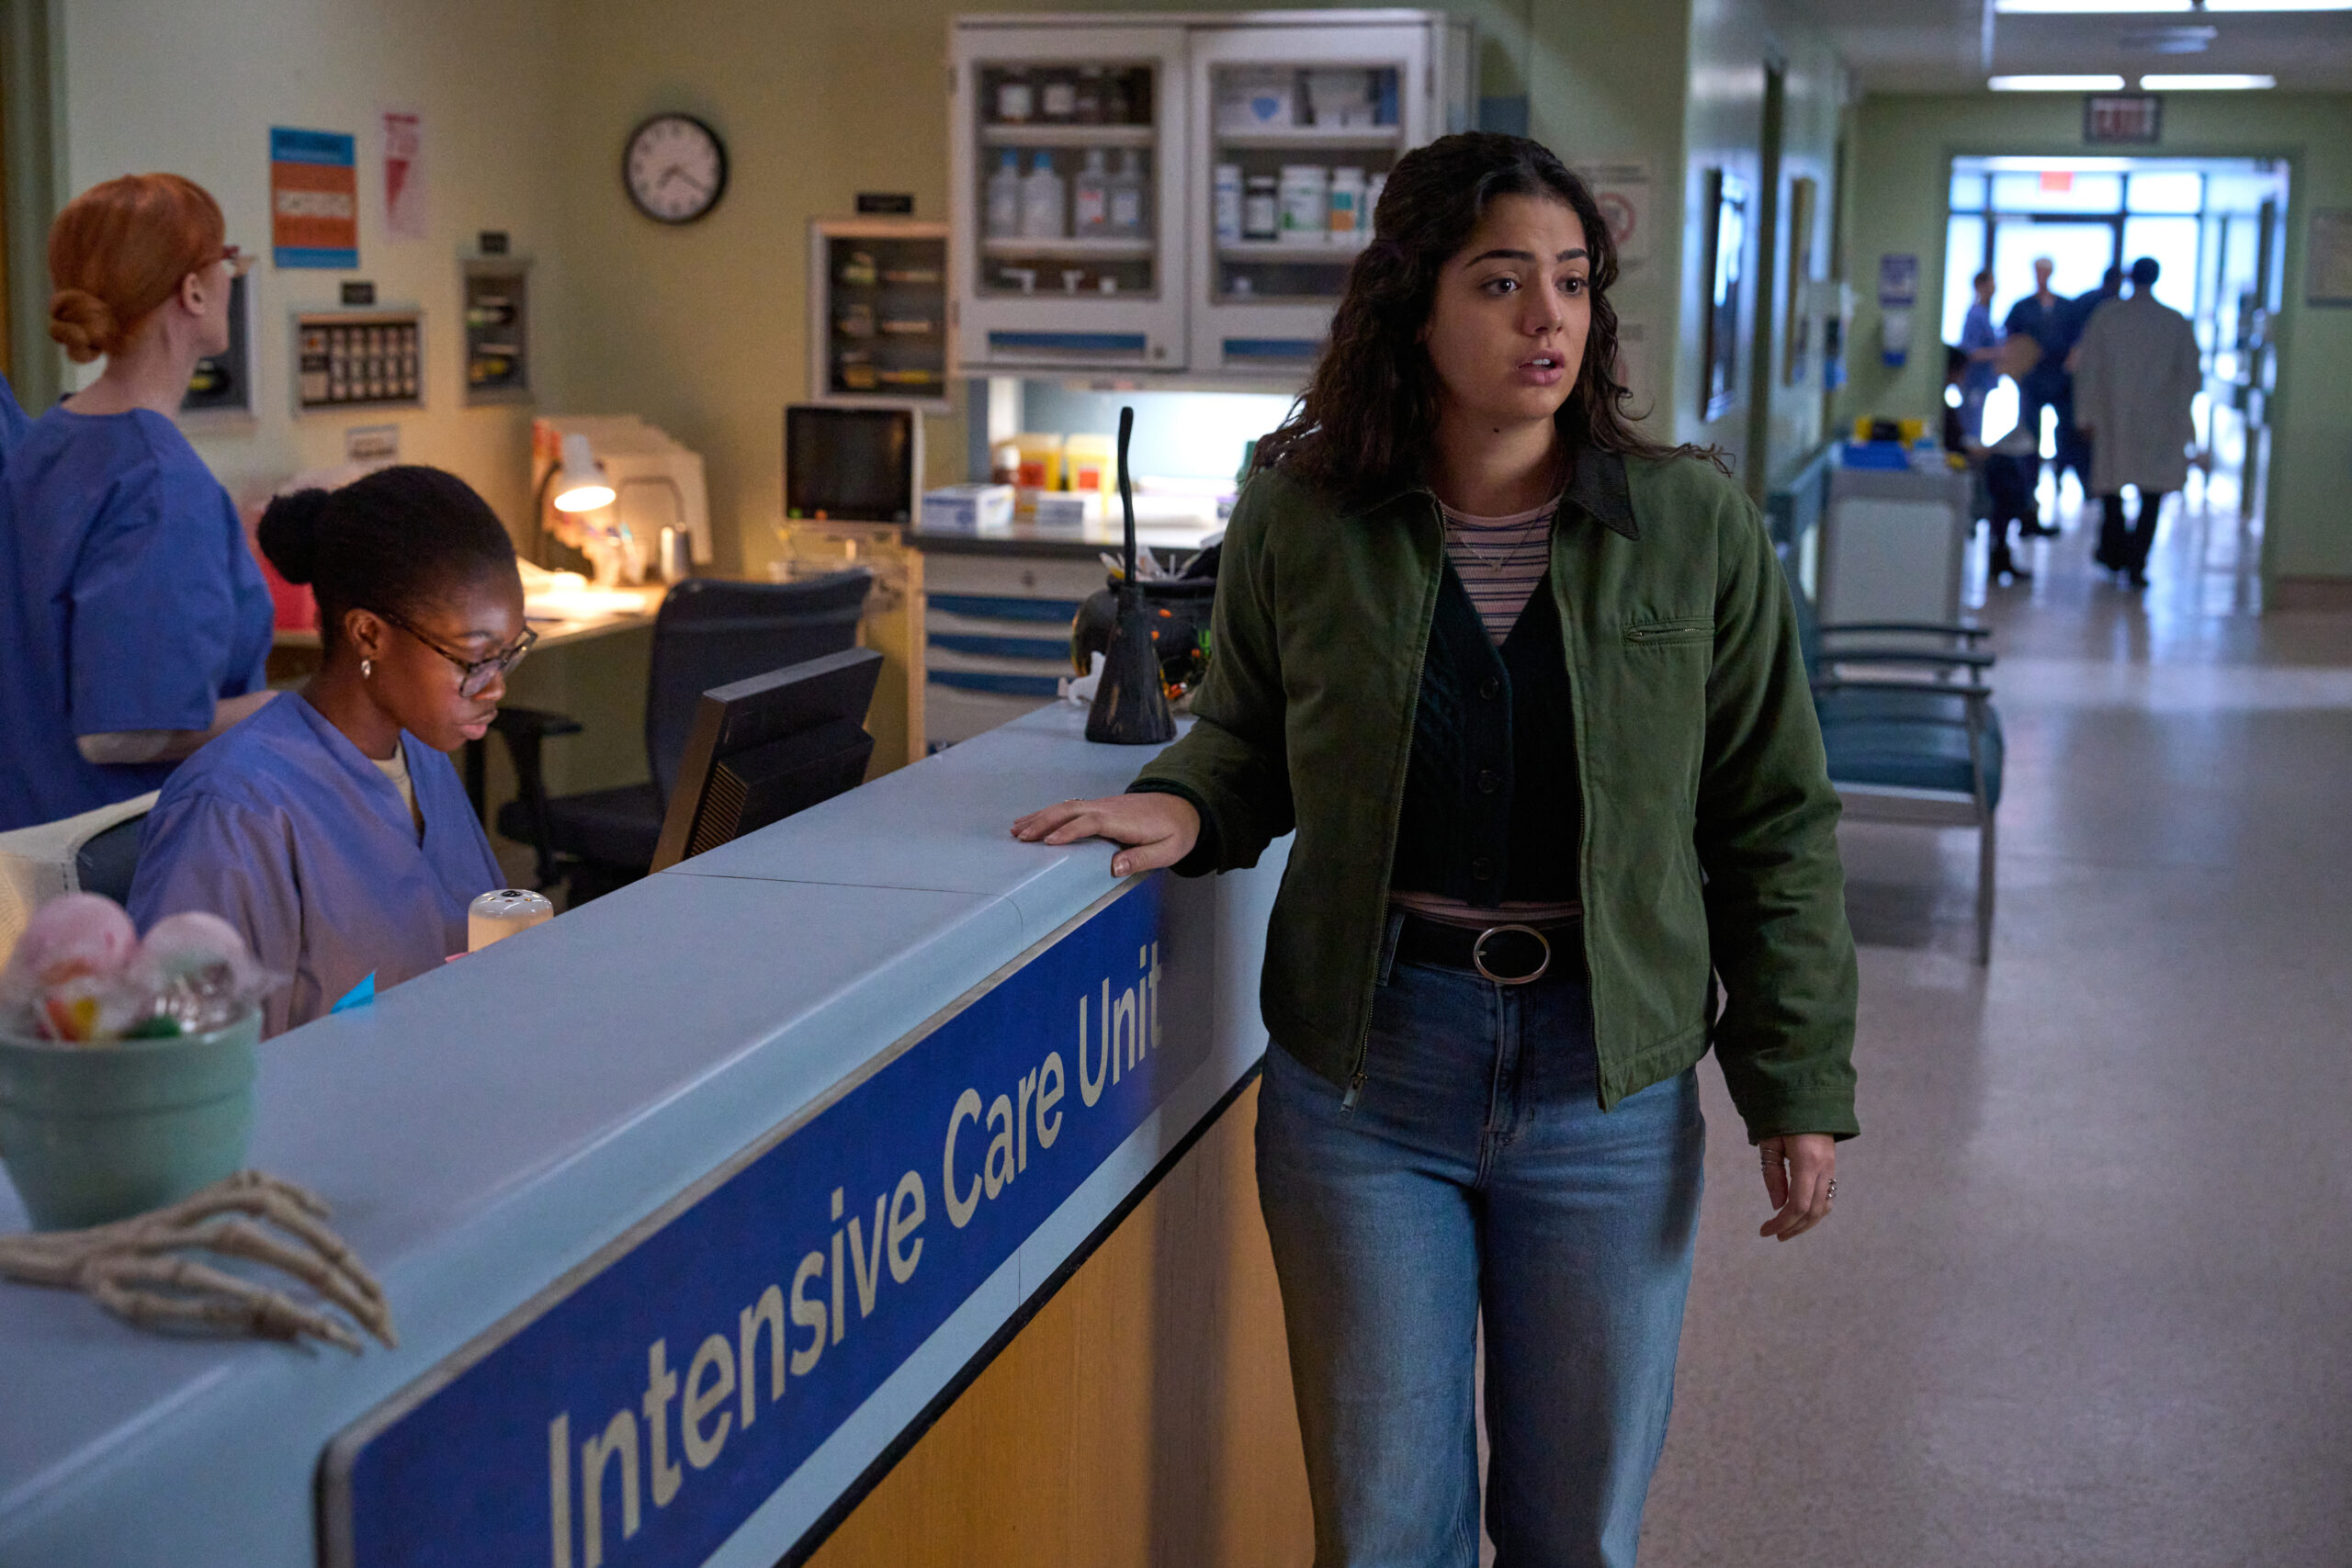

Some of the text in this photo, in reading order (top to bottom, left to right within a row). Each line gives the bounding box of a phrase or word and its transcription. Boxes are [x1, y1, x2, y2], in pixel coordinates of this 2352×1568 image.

[549, 940, 1163, 1568] Intensive Care Unit
